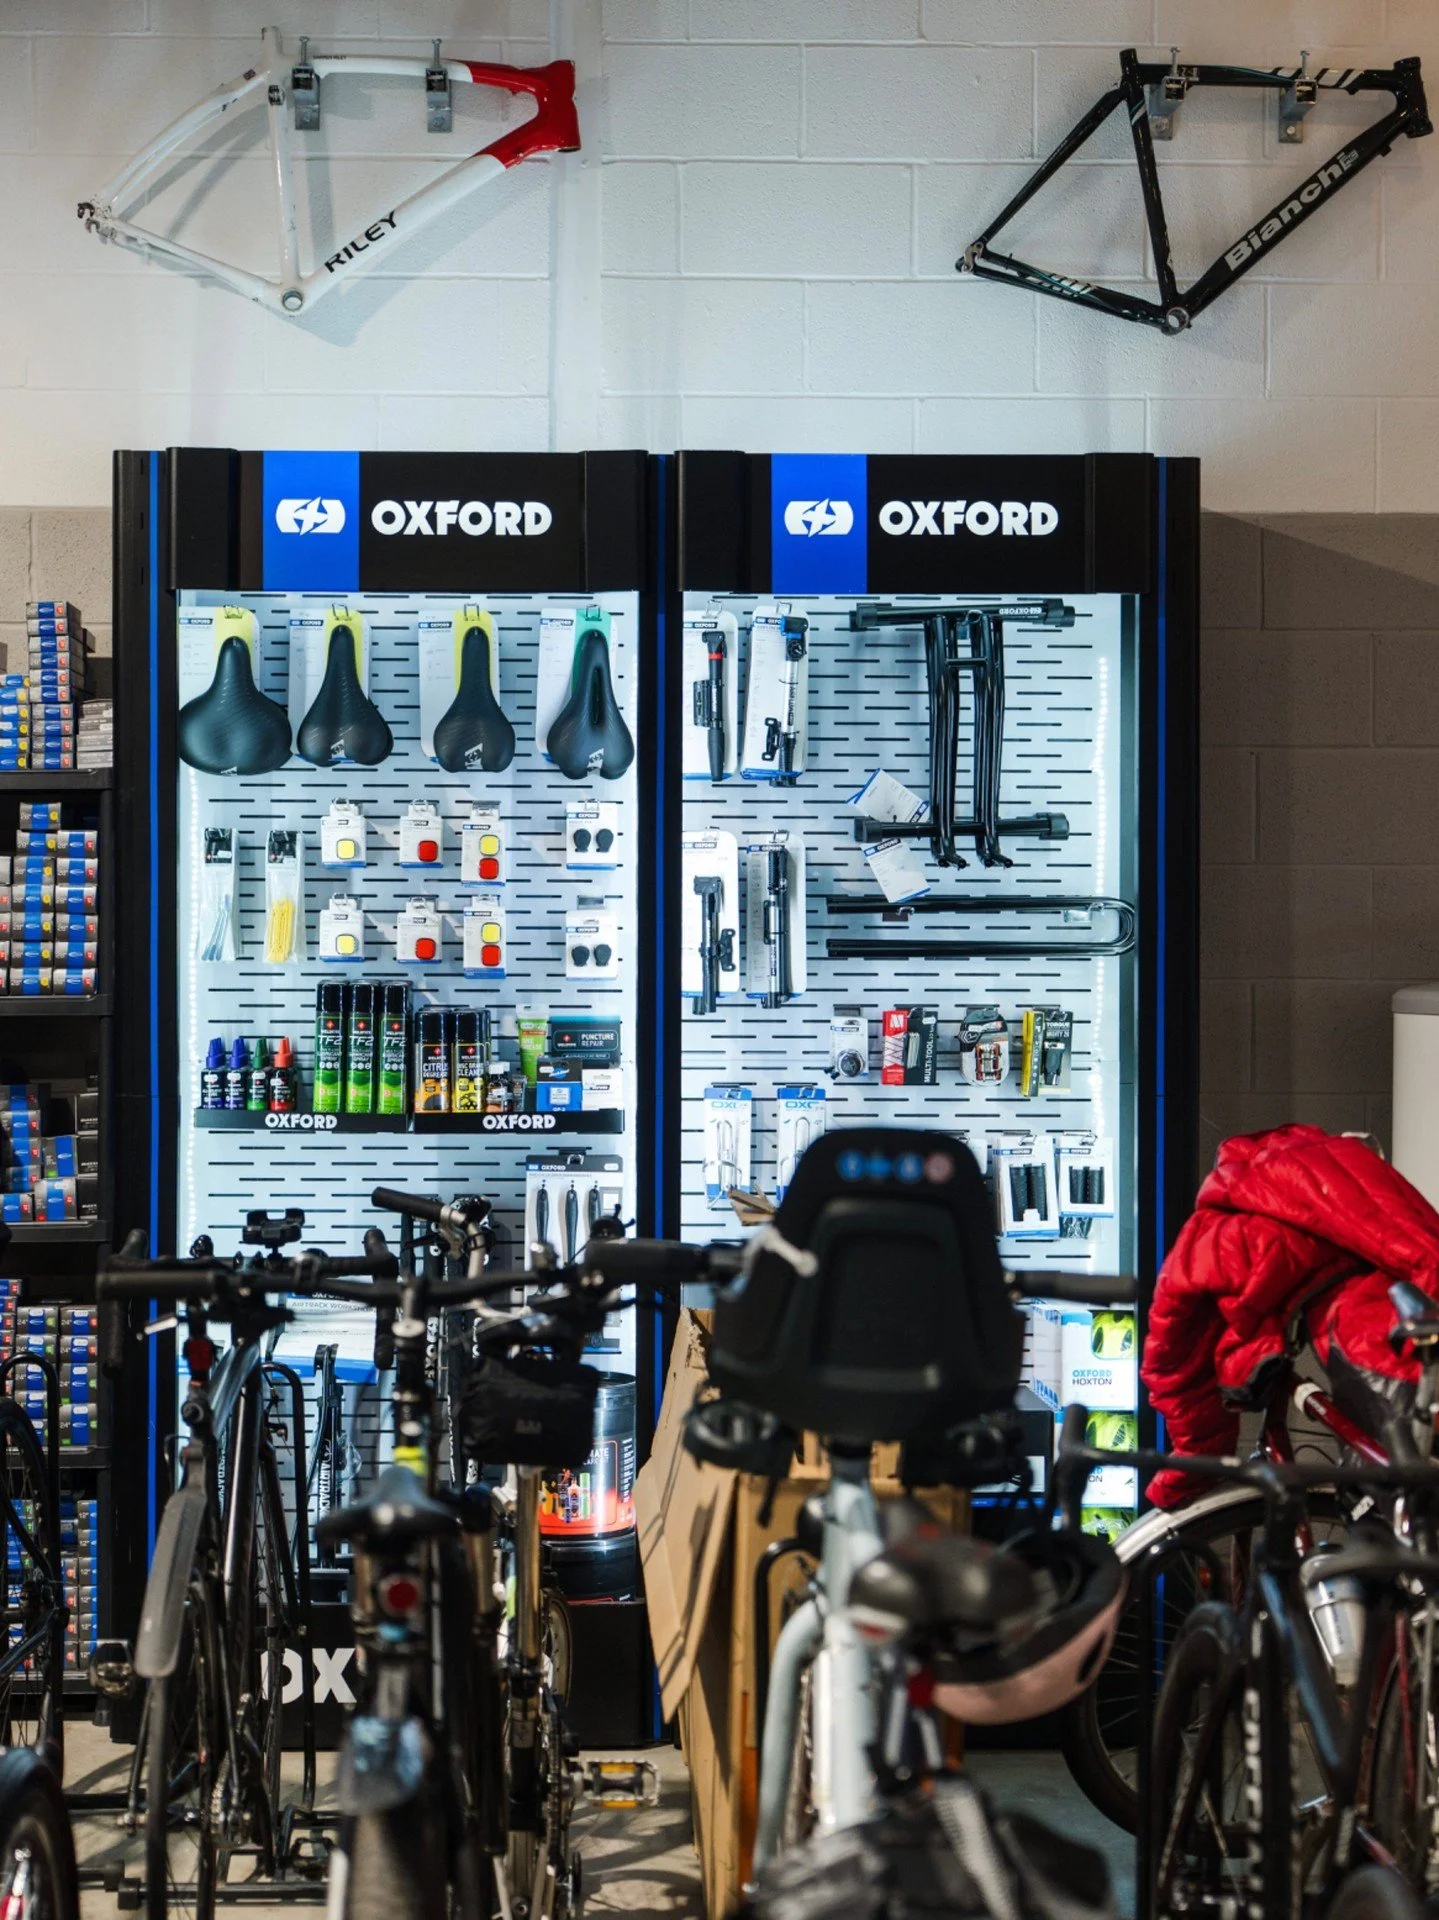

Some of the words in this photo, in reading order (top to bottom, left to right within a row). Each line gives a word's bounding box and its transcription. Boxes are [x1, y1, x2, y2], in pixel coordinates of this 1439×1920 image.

[324, 210, 396, 273] RILEY
[371, 500, 553, 536] OXFORD
[879, 500, 1059, 536] OXFORD
[766, 618, 782, 626] OXFO
[318, 1035, 342, 1045] TF2
[349, 1036, 374, 1046] TF2
[384, 1037, 407, 1046] TF2
[924, 1039, 934, 1083] MULTI-TOOL
[265, 1113, 338, 1129] OXFORD
[482, 1114, 557, 1130] OXFORD
[1072, 1369, 1112, 1378] OXFORD
[319, 1462, 331, 1512] AIRTRACK
